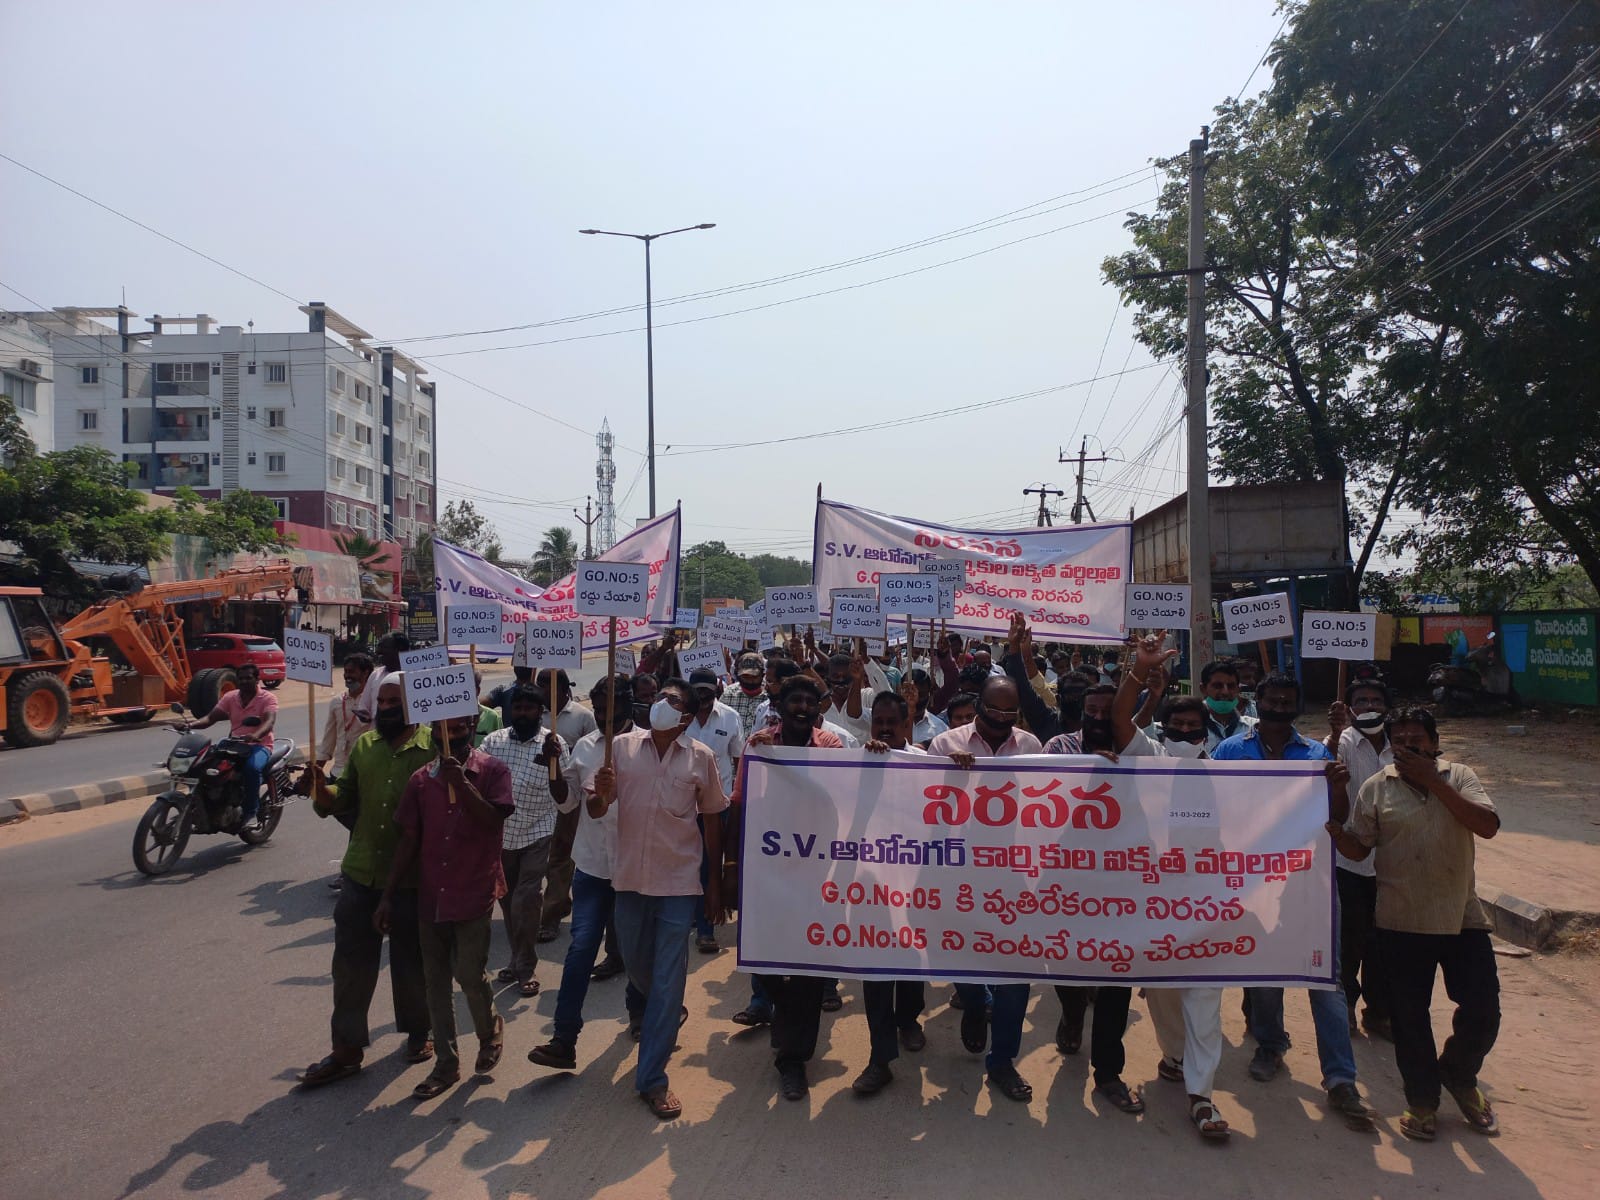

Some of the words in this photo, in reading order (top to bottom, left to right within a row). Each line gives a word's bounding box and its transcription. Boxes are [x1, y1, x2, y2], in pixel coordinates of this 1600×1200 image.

[825, 542, 861, 559] S.V.
[925, 563, 960, 572] GO.NO:5
[585, 570, 639, 585] GO.NO:5
[887, 580, 932, 589] GO.NO:5
[580, 591, 600, 605] రద్దు
[604, 590, 641, 603] చేయాలి
[772, 592, 813, 601] GO.NO:5
[884, 596, 902, 607] రద్దు
[904, 595, 934, 604] చేయాలి
[1031, 590, 1083, 604] నిరసన
[1133, 591, 1183, 601] GO.NO:5
[770, 605, 786, 618] రద్దు
[787, 605, 815, 613] చేయాలి
[1130, 608, 1151, 621] రద్దు
[1152, 607, 1186, 617] చేయాలి
[1231, 600, 1281, 615] GO.NO:5
[454, 611, 495, 621] GO.NO:5
[1029, 608, 1090, 626] చేయాలి
[713, 621, 741, 633] GO.NO:5
[837, 618, 851, 629] రద్దు
[854, 618, 882, 627] చేయాలి
[1231, 621, 1253, 635] రద్దు
[1254, 615, 1286, 629] చేయాలి
[1311, 620, 1367, 631] GO.NO:5
[452, 626, 467, 638] రద్దు
[469, 625, 497, 634] చేయాలి
[533, 628, 574, 640] GO.NO:5
[286, 636, 325, 652] GO.NO:5
[1308, 638, 1329, 651] రద్దు
[1331, 638, 1369, 648] చేయాలి
[405, 652, 443, 665] GO.NO:5
[531, 647, 547, 660] రద్దు
[548, 646, 577, 656] చేయాలి
[683, 650, 718, 663] GO.NO:5
[286, 657, 299, 670] రద్దు
[301, 659, 327, 671] చేయాలి
[413, 672, 466, 690] GO.NO:5
[412, 698, 432, 713] రద్దు
[435, 690, 471, 705] చేయాలి
[923, 778, 1121, 830] నిరసన
[1169, 811, 1211, 819] 31-03-2022
[761, 831, 826, 860] S.V.
[830, 834, 966, 867] ఆటోనగర్
[972, 844, 1096, 878] కార్మికుల
[1103, 846, 1187, 884] ఐక్యత
[821, 881, 942, 910] G.O.No:05
[956, 883, 975, 913] కి
[983, 883, 1137, 925] వ్యతిరేకంగా
[1145, 895, 1245, 922] నిరసన
[807, 923, 928, 950] G.O.No:05
[941, 930, 965, 952] ని
[973, 929, 1070, 960] వెంటనే
[1077, 936, 1135, 973] రద్దు
[1143, 934, 1256, 961] చేయాలి
